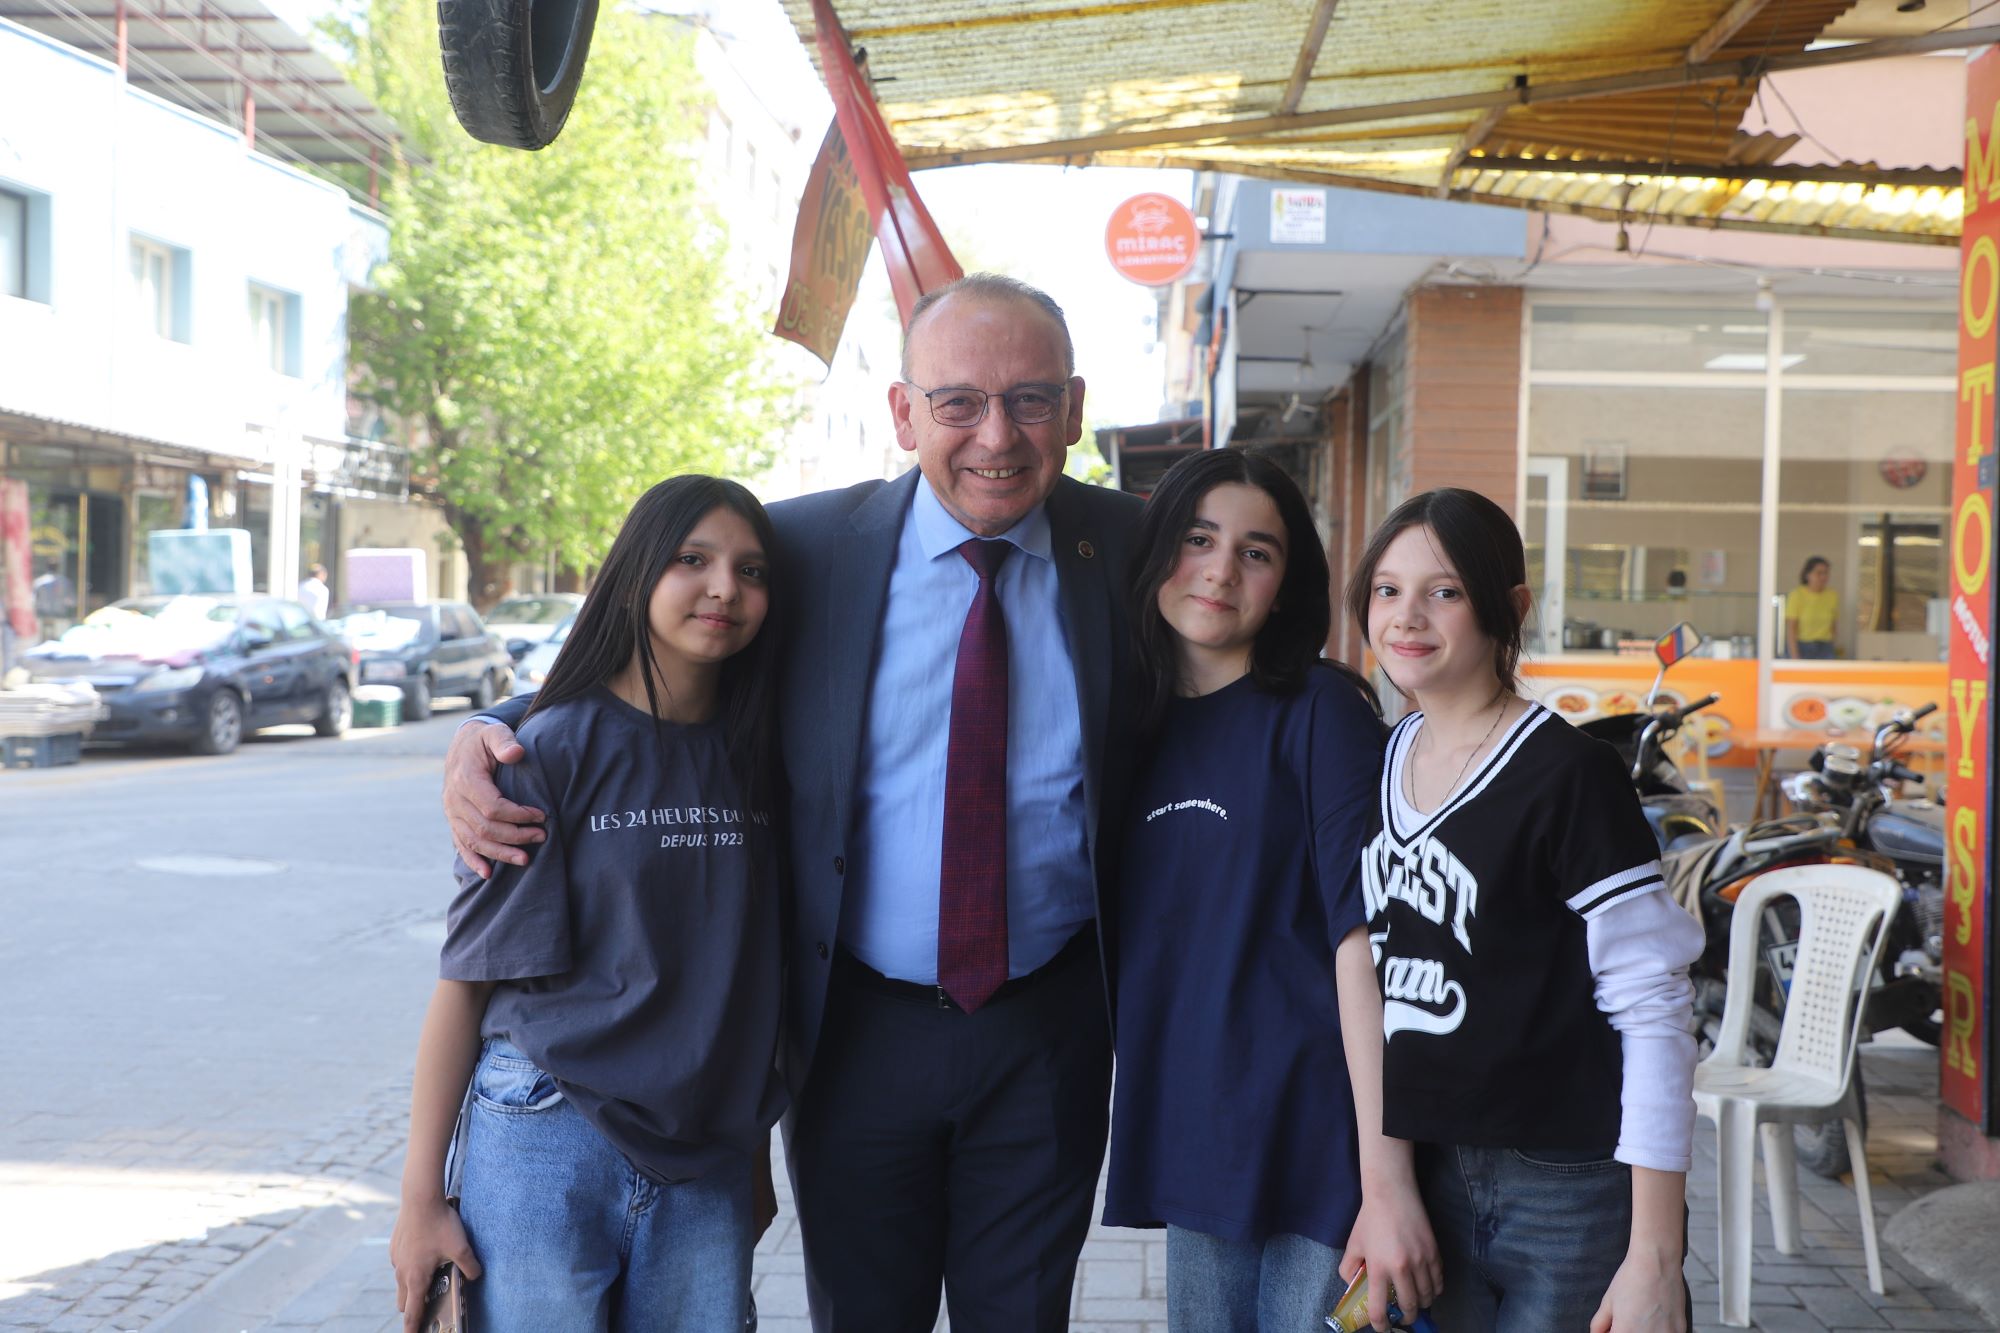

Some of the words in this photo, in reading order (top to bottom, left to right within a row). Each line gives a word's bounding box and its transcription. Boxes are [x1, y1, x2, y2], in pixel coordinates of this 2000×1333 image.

[1951, 99, 2000, 594] MOTO
[590, 813, 621, 832] LES
[625, 809, 648, 828] 24
[652, 807, 720, 825] HEURES
[723, 808, 745, 823] DU
[1146, 802, 1173, 822] start
[1174, 798, 1228, 820] somewhere.
[660, 833, 709, 848] DEPUIS
[713, 833, 744, 847] 1923
